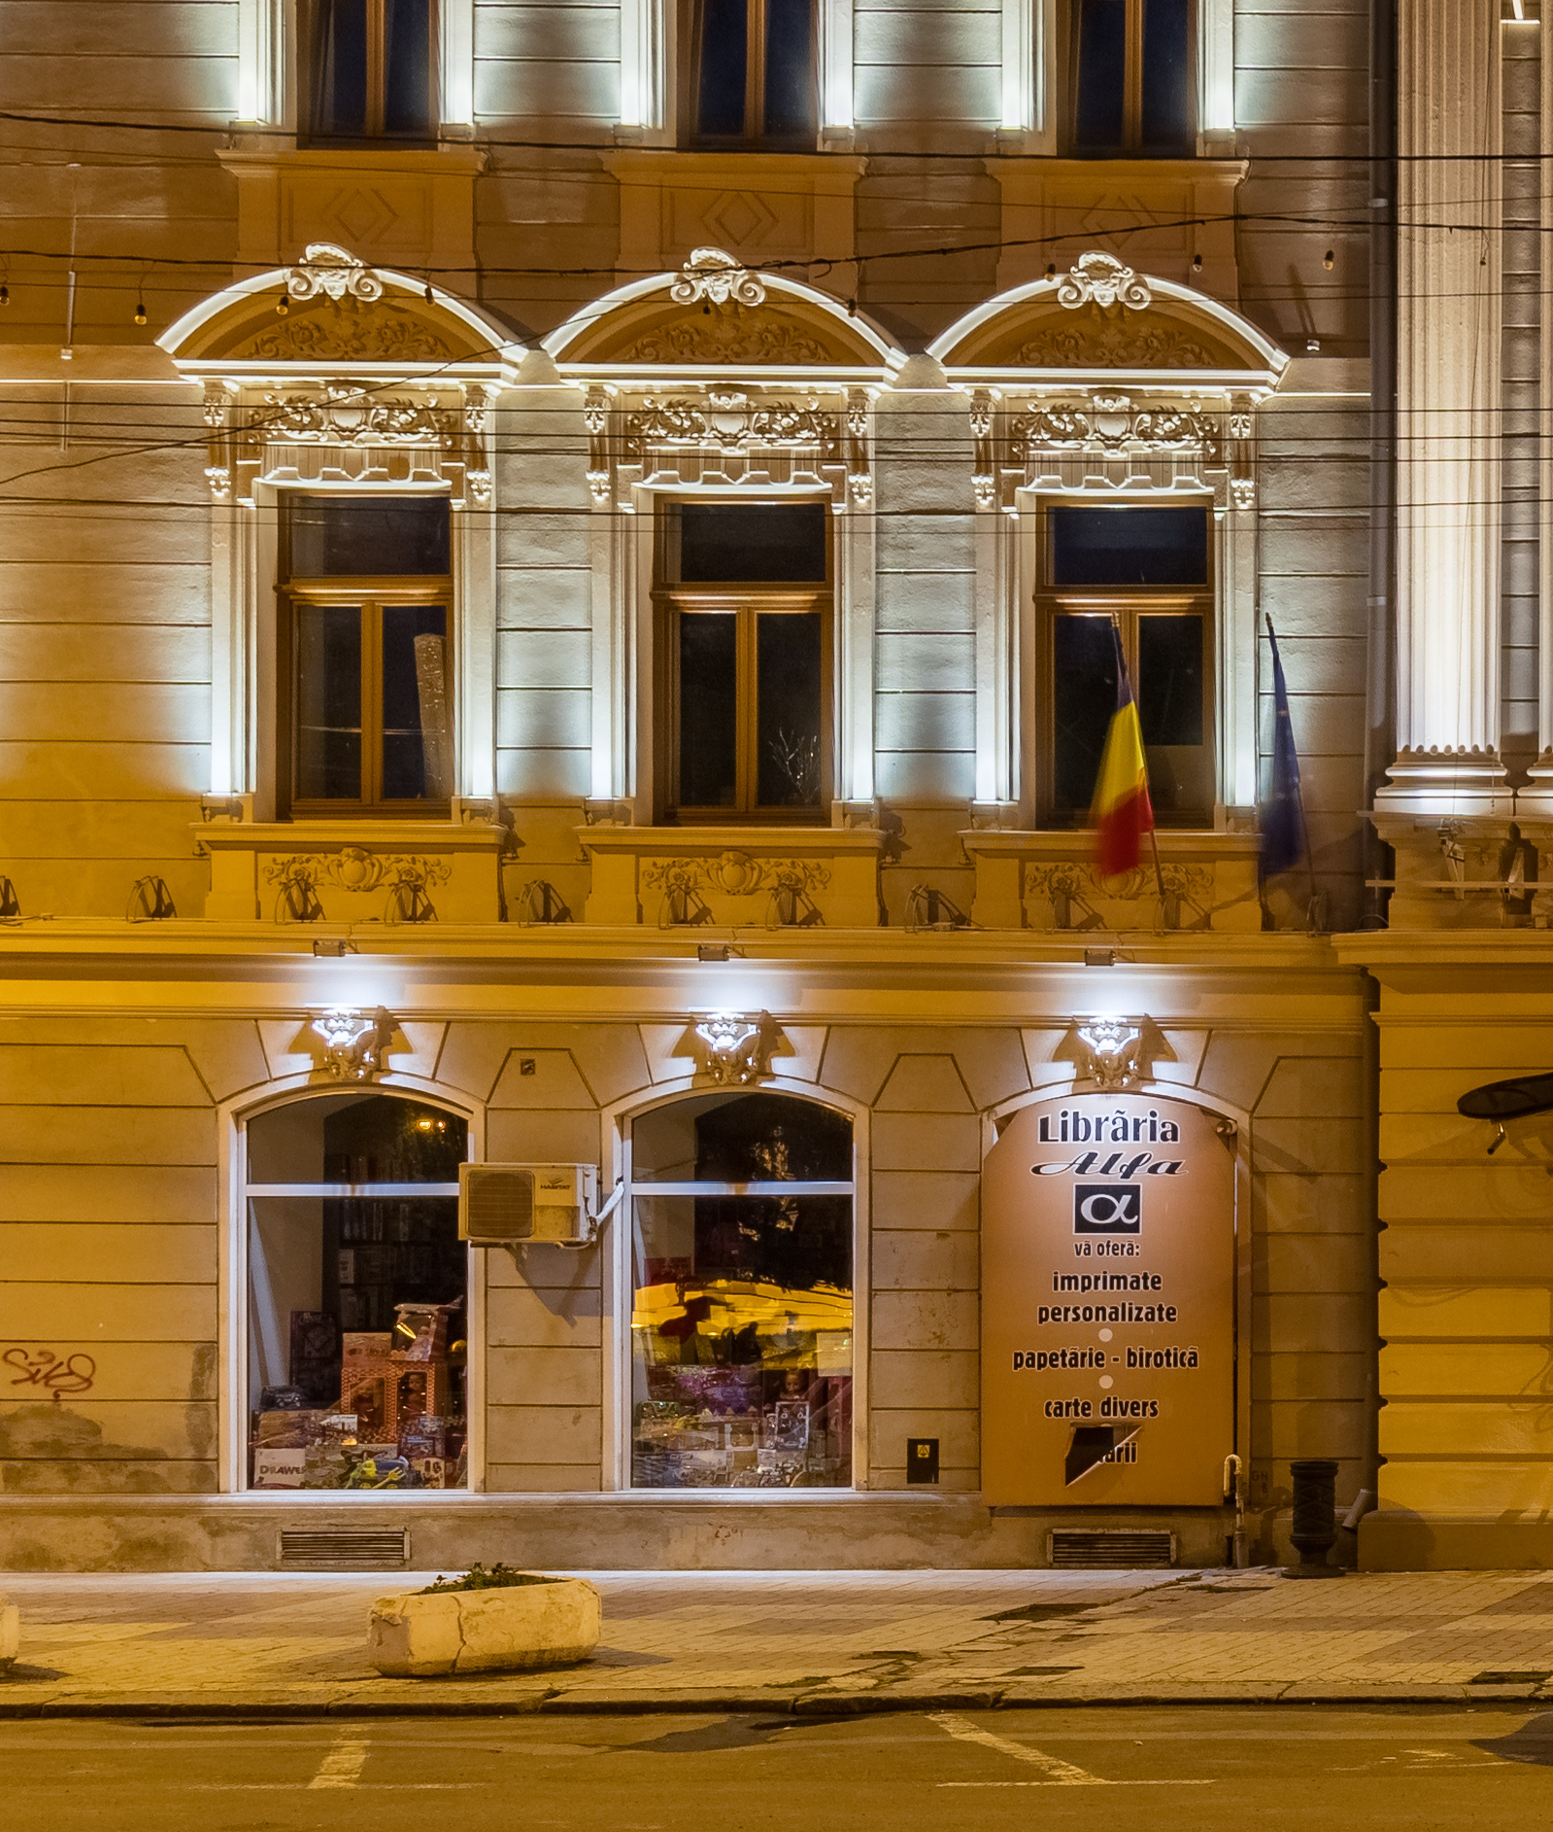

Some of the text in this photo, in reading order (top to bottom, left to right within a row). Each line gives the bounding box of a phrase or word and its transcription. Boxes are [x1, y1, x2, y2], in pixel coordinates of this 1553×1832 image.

[1030, 1151, 1189, 1180] Alfa
[1053, 1271, 1162, 1293] imprimate
[1038, 1302, 1177, 1324] personalizate
[1044, 1396, 1159, 1418] carte divers
[259, 1464, 306, 1475] DRAWE
